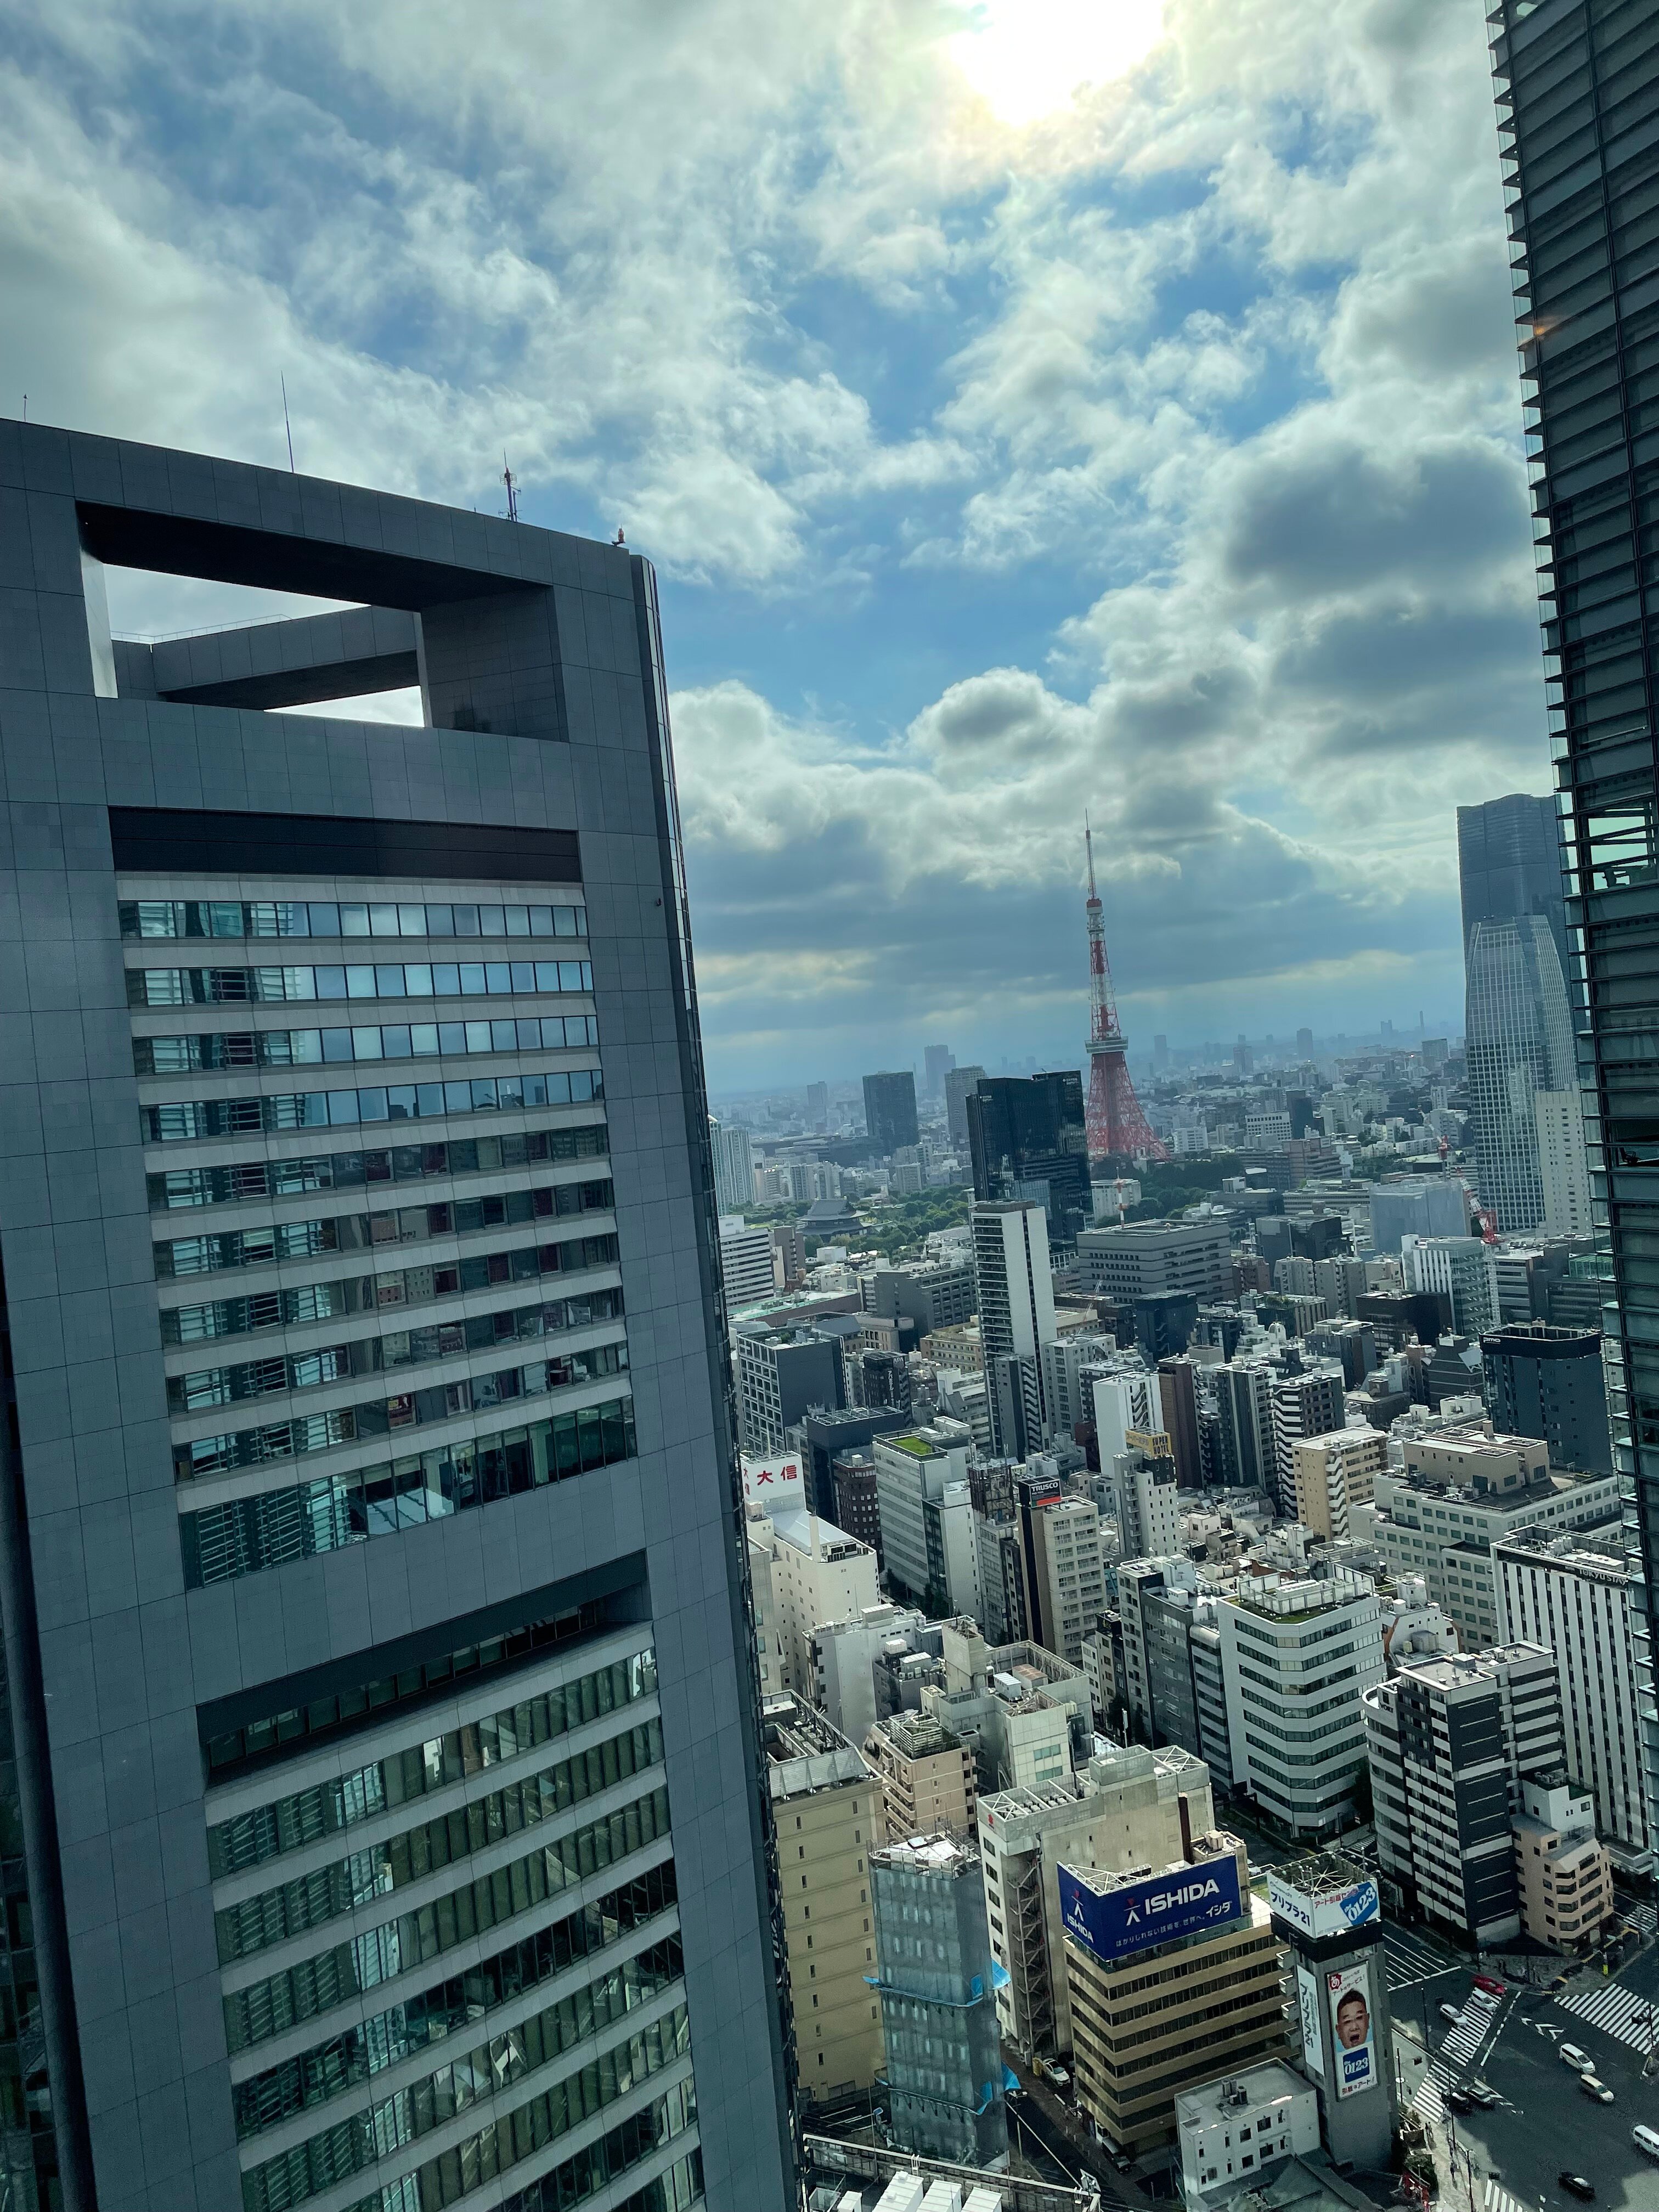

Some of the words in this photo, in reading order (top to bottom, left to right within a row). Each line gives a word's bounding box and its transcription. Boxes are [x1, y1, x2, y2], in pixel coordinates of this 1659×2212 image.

[1153, 1436, 1168, 1446] SUPER
[1154, 1444, 1169, 1454] HOTEL
[757, 1465, 797, 1486] 大信
[1031, 1482, 1058, 1492] TRUSCO
[1579, 1569, 1605, 1580] TOKYU
[1145, 1879, 1220, 1915] ISHIDA
[1347, 1887, 1376, 1921] 0123
[1205, 1900, 1233, 1917] イシダ
[1067, 1913, 1094, 1944] ISHIDA
[1344, 2057, 1369, 2075] 0123
